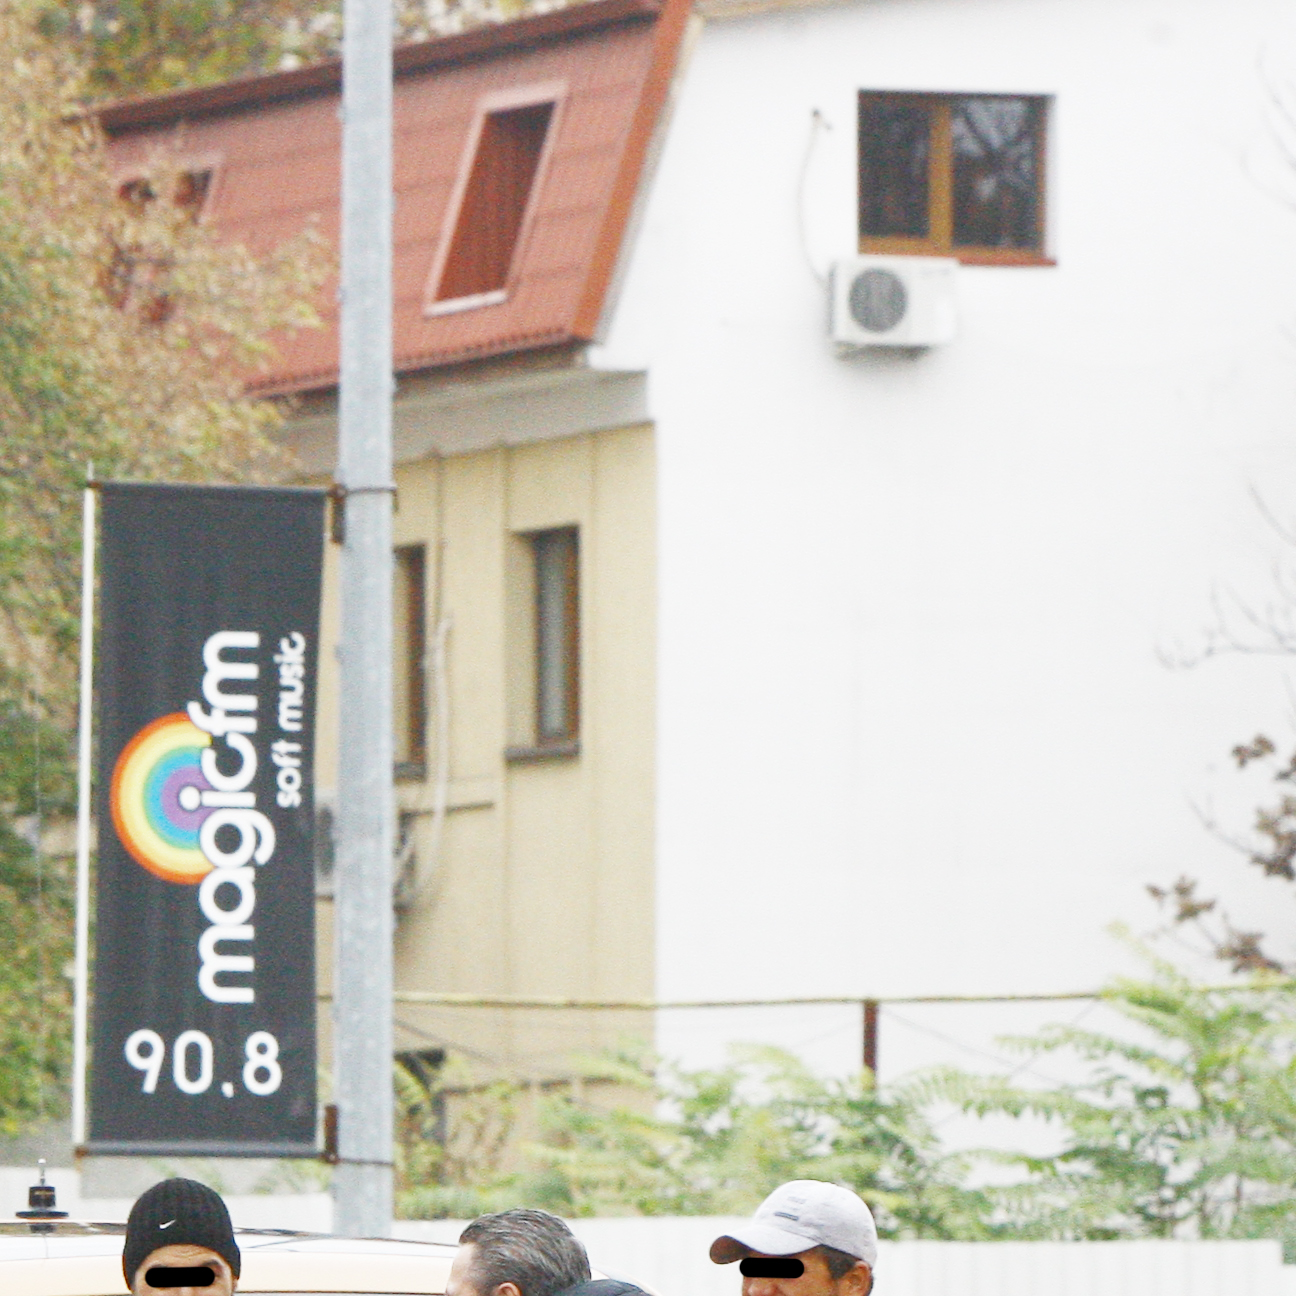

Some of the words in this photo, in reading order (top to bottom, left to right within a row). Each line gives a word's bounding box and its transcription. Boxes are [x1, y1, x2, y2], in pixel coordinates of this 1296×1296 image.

[272, 631, 306, 732] music
[271, 739, 302, 808] soft
[124, 1028, 283, 1098] 90.8
